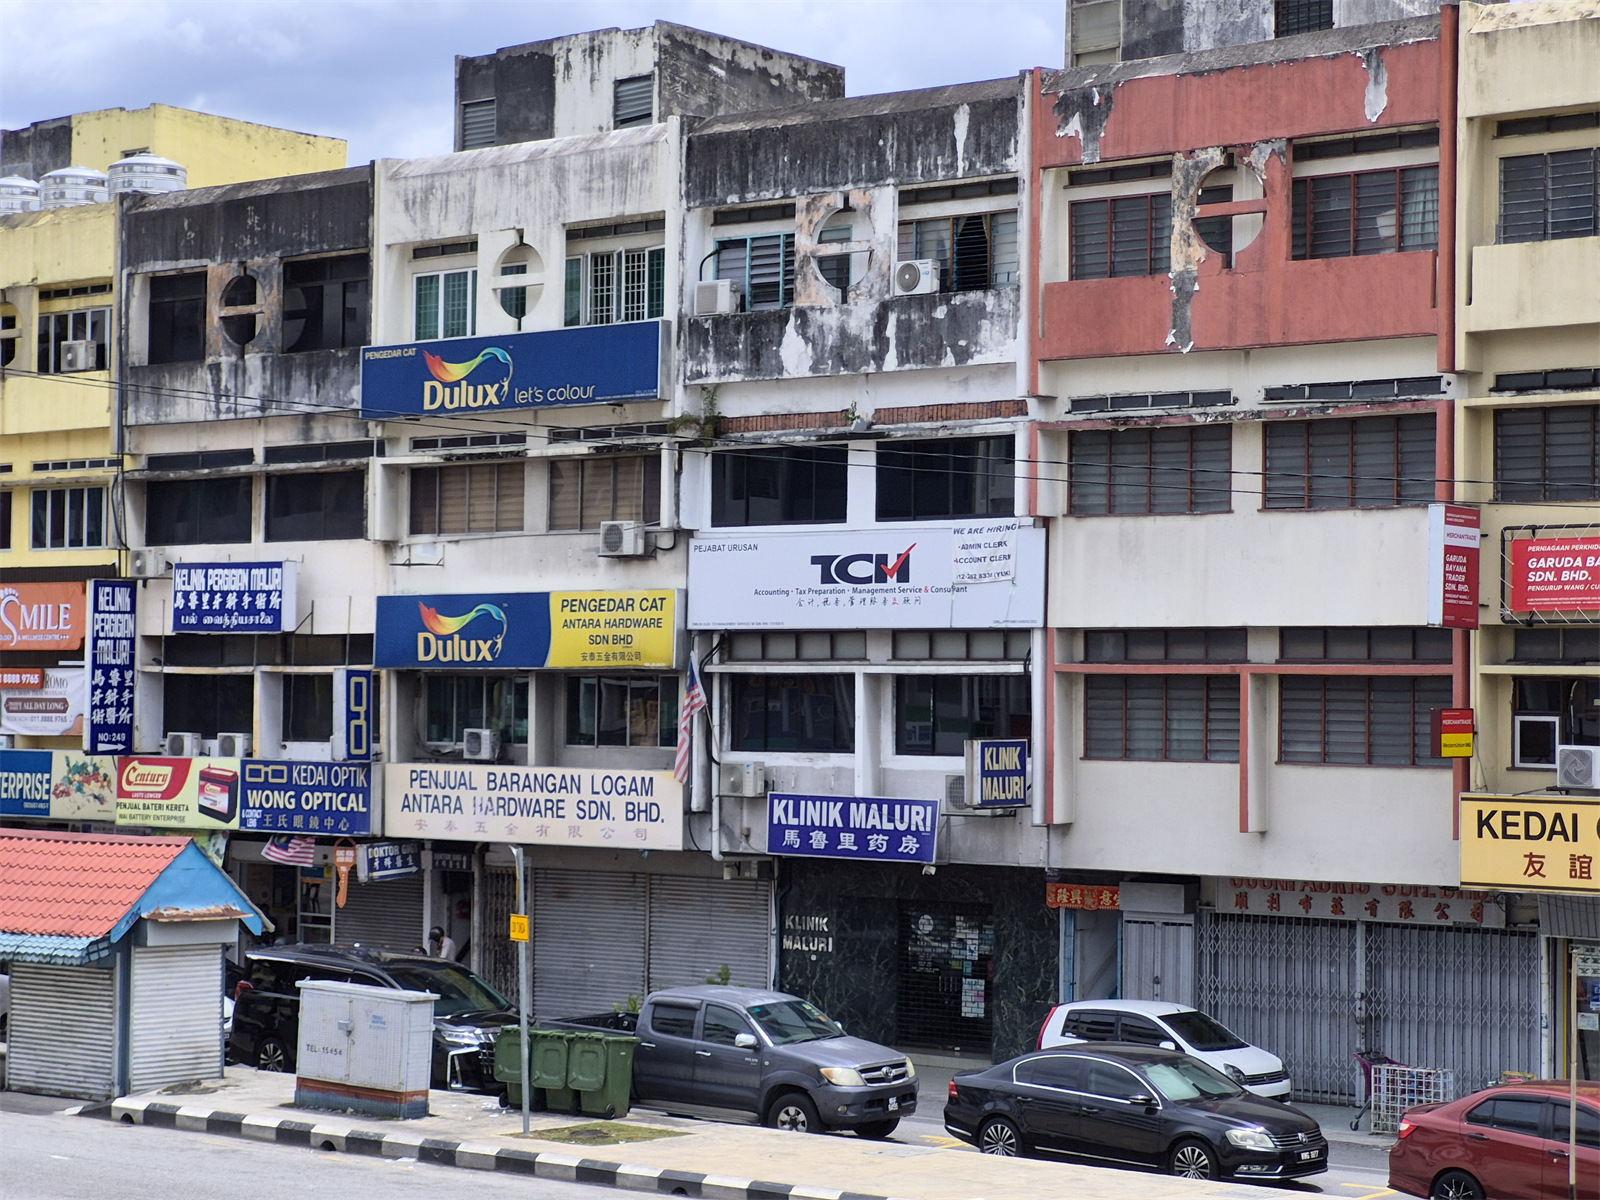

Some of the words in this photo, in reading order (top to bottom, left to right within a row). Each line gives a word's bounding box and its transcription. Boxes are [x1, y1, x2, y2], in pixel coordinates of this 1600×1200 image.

[365, 351, 402, 360] PENGEDAR
[403, 348, 417, 356] CAT
[424, 380, 500, 410] Dulux
[514, 387, 544, 404] let's
[547, 384, 596, 402] colour
[987, 523, 1017, 533] HIRING
[984, 540, 1007, 549] CLERK
[1445, 554, 1467, 563] GARUDA
[1528, 557, 1582, 568] GARUDA
[1445, 564, 1467, 573] BAYANA
[1527, 571, 1557, 582] SDN.
[1561, 570, 1592, 581] BHD.
[1445, 574, 1465, 582] TRADER
[754, 588, 789, 597] Accounting
[808, 587, 846, 596] Preparation
[852, 586, 897, 596] Management
[898, 586, 923, 594] Service
[561, 598, 635, 612] PENGEDAR
[639, 597, 667, 612] CAT
[562, 618, 602, 629] ANTARA
[604, 618, 663, 628] HARDWARE
[418, 632, 494, 662] Dulux
[588, 634, 609, 645] SDN
[612, 634, 633, 645] BHD
[97, 639, 130, 665] MALURI
[581, 652, 642, 662] 安泰五金有限公司
[21, 674, 40, 684] 9765
[47, 702, 64, 711] LONG
[984, 746, 1021, 771] KLINIK
[125, 765, 169, 787] Century
[292, 764, 328, 787] KEDAI
[330, 766, 368, 787] OPTIK
[410, 769, 478, 790] PENJUAL
[487, 771, 581, 795] BARANGAN
[591, 773, 654, 797] LOGAM
[982, 776, 1024, 800] MALURI
[116, 802, 141, 811] PENJUAL
[142, 803, 165, 811] BATERI
[166, 804, 189, 812] KERETA
[247, 789, 296, 809] WONG
[301, 791, 367, 812] OPTICAL
[401, 793, 463, 814] ANTARA
[473, 796, 565, 818] HARDWARE
[576, 800, 616, 821] SDN.
[625, 801, 664, 823] BHD.
[263, 812, 350, 831] 王氏眼鏡中心
[773, 799, 844, 828] KLINIK
[850, 802, 932, 832] MALURI
[414, 819, 648, 841] 安泰五金有限公司
[1477, 809, 1579, 842] KEDAI
[782, 829, 920, 854] 馬魯里药房
[368, 845, 400, 859] DOKTOR
[1523, 852, 1592, 880] 友誼
[785, 915, 829, 932] KLINIK
[783, 935, 832, 952] MALURI
